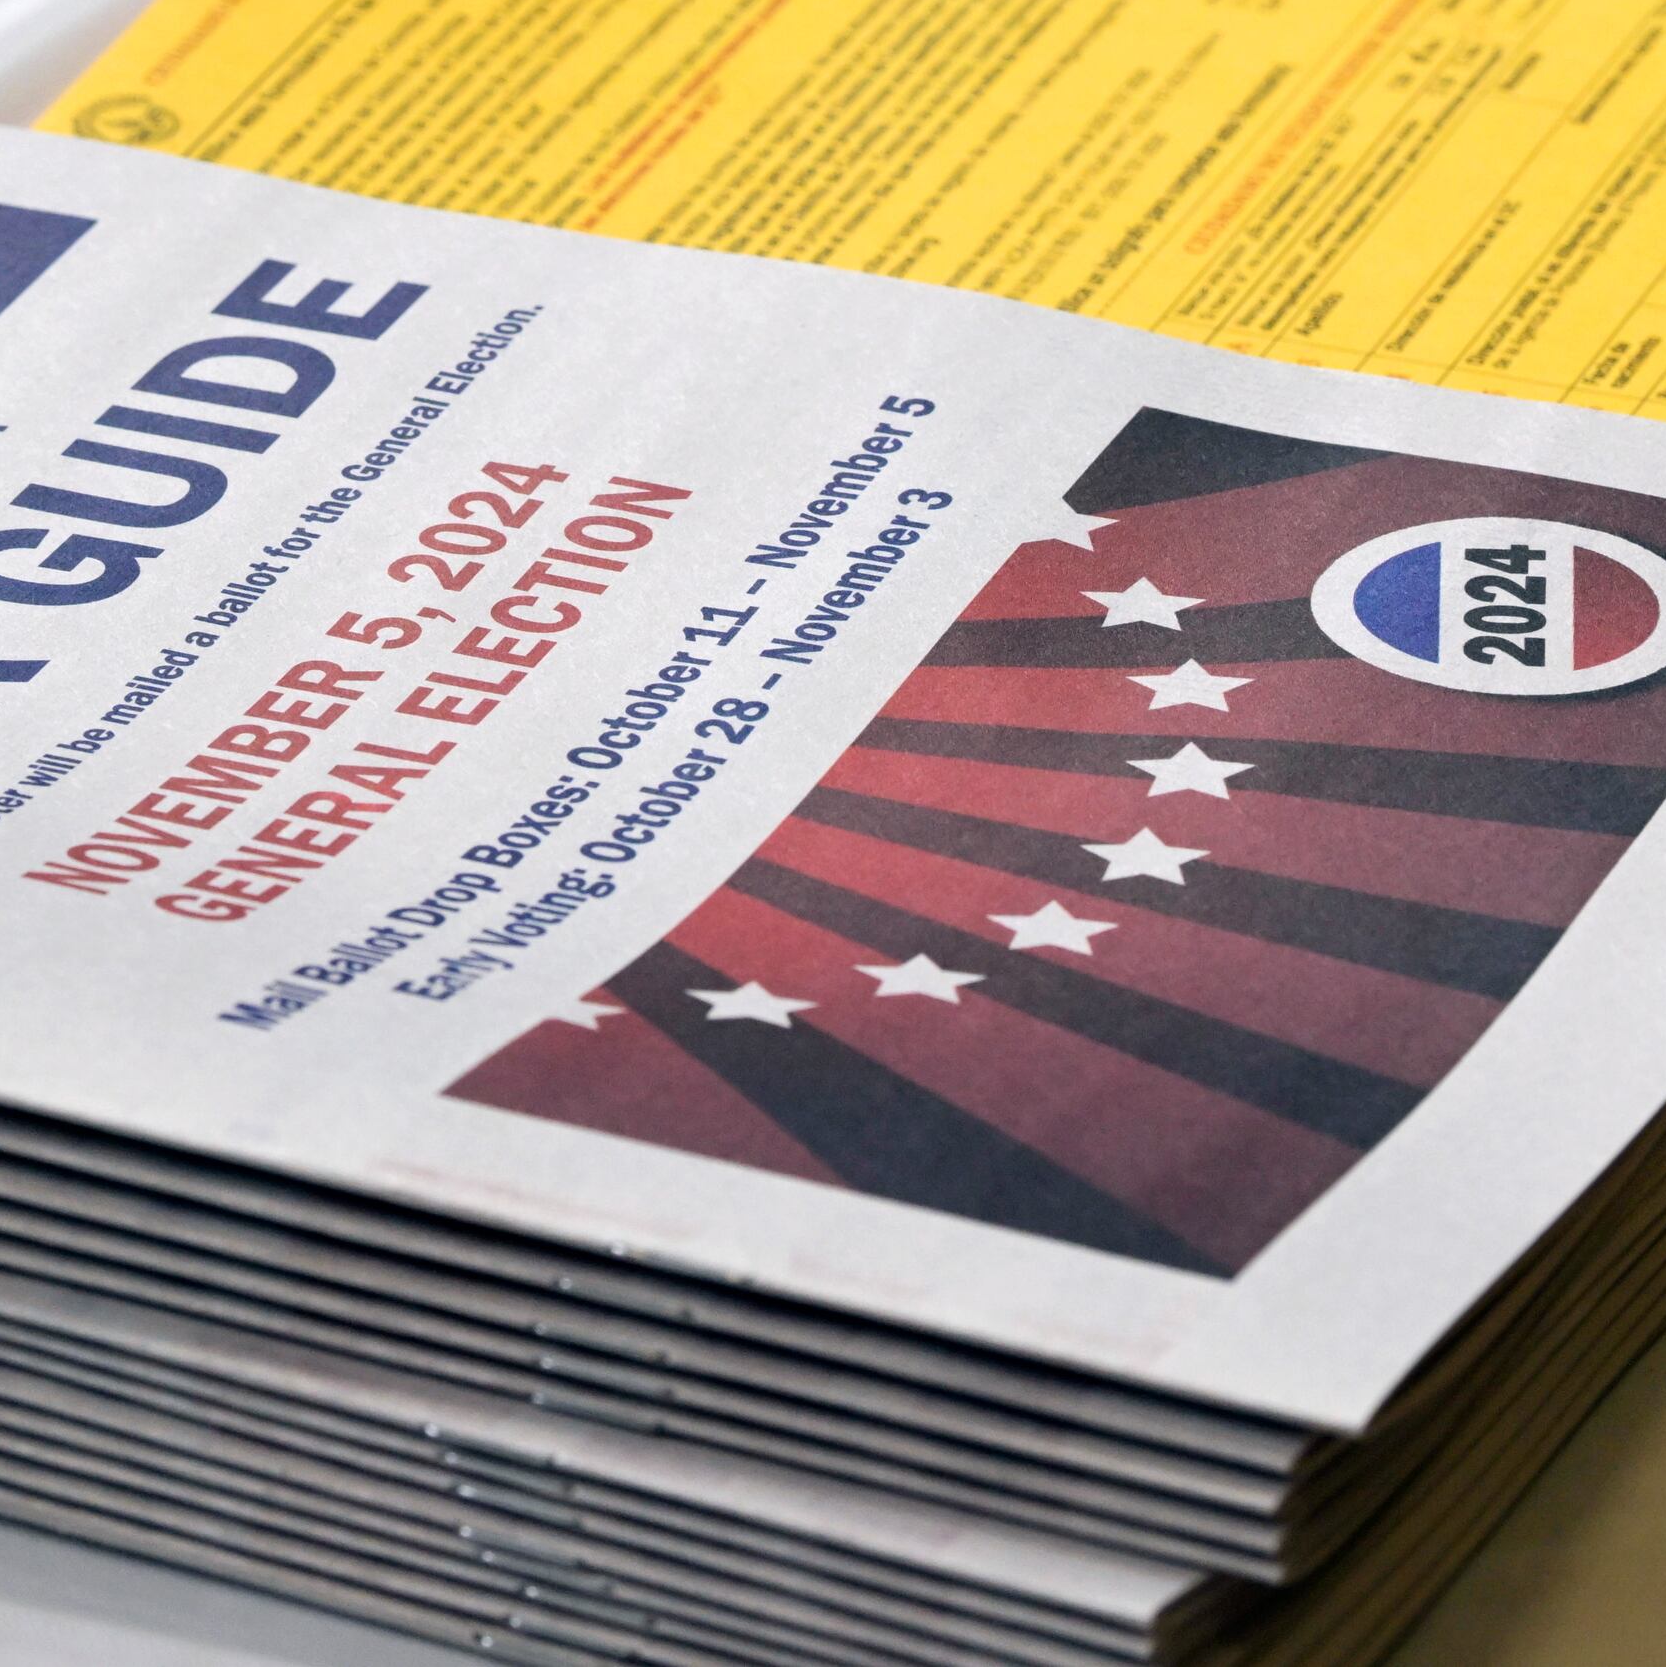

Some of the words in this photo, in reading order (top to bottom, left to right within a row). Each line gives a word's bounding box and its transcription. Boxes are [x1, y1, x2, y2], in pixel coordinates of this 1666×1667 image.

[424, 305, 544, 395] Election.
[340, 396, 451, 482] General
[262, 526, 322, 560] for
[299, 487, 363, 524] the
[387, 461, 570, 593] 2024
[193, 561, 290, 628] ballot
[325, 606, 457, 650] 5,
[1463, 544, 1547, 667] 2024
[184, 631, 221, 648] a
[100, 648, 200, 726] mailed
[154, 740, 458, 923] GENERAL
[394, 476, 694, 726] ELECTION
[218, 980, 326, 1030] Mail
[292, 926, 424, 986] Ballot
[386, 872, 502, 928] Drop
[460, 775, 601, 869] Boxes:
[566, 650, 713, 770] October
[682, 605, 760, 647] 11
[744, 422, 913, 570] November
[879, 395, 936, 418] 5
[18, 753, 83, 788] will
[21, 659, 385, 896] NOVEMBER
[56, 728, 116, 754] be
[392, 949, 514, 1002] Early
[468, 868, 617, 948] Voting:
[579, 747, 728, 863] October
[694, 697, 770, 745] 28
[759, 514, 931, 665] November
[897, 488, 954, 511] 3
